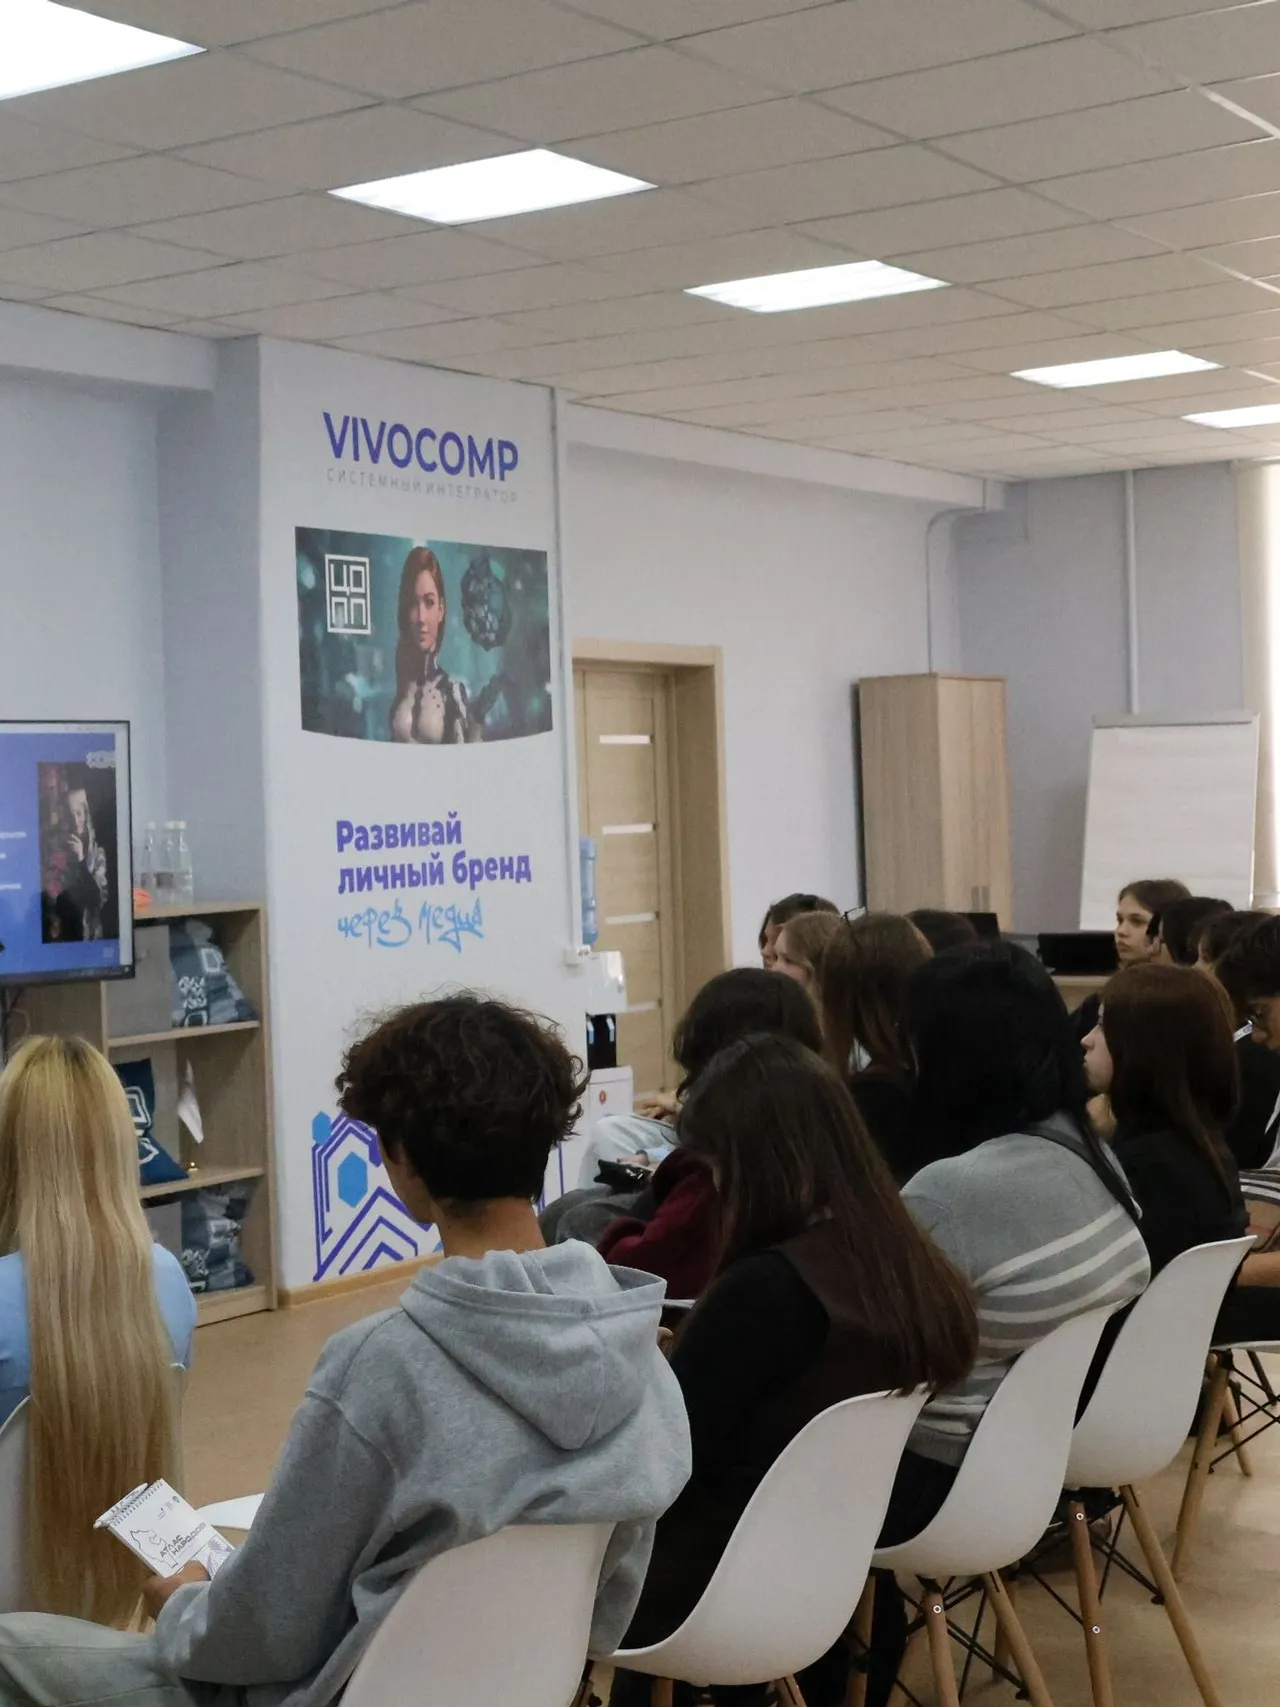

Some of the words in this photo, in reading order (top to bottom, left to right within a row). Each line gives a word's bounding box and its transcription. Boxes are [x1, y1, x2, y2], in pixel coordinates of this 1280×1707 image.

[322, 412, 518, 482] VIVOCOMP
[326, 467, 421, 494] СИСТЕМНЫЙ
[426, 481, 518, 504] ИНТЕГРАТОР
[336, 811, 462, 853] Развивай
[338, 852, 445, 894] личный
[452, 850, 532, 891] бренд
[337, 897, 412, 949] через
[160, 1534, 184, 1557] АТЛАС
